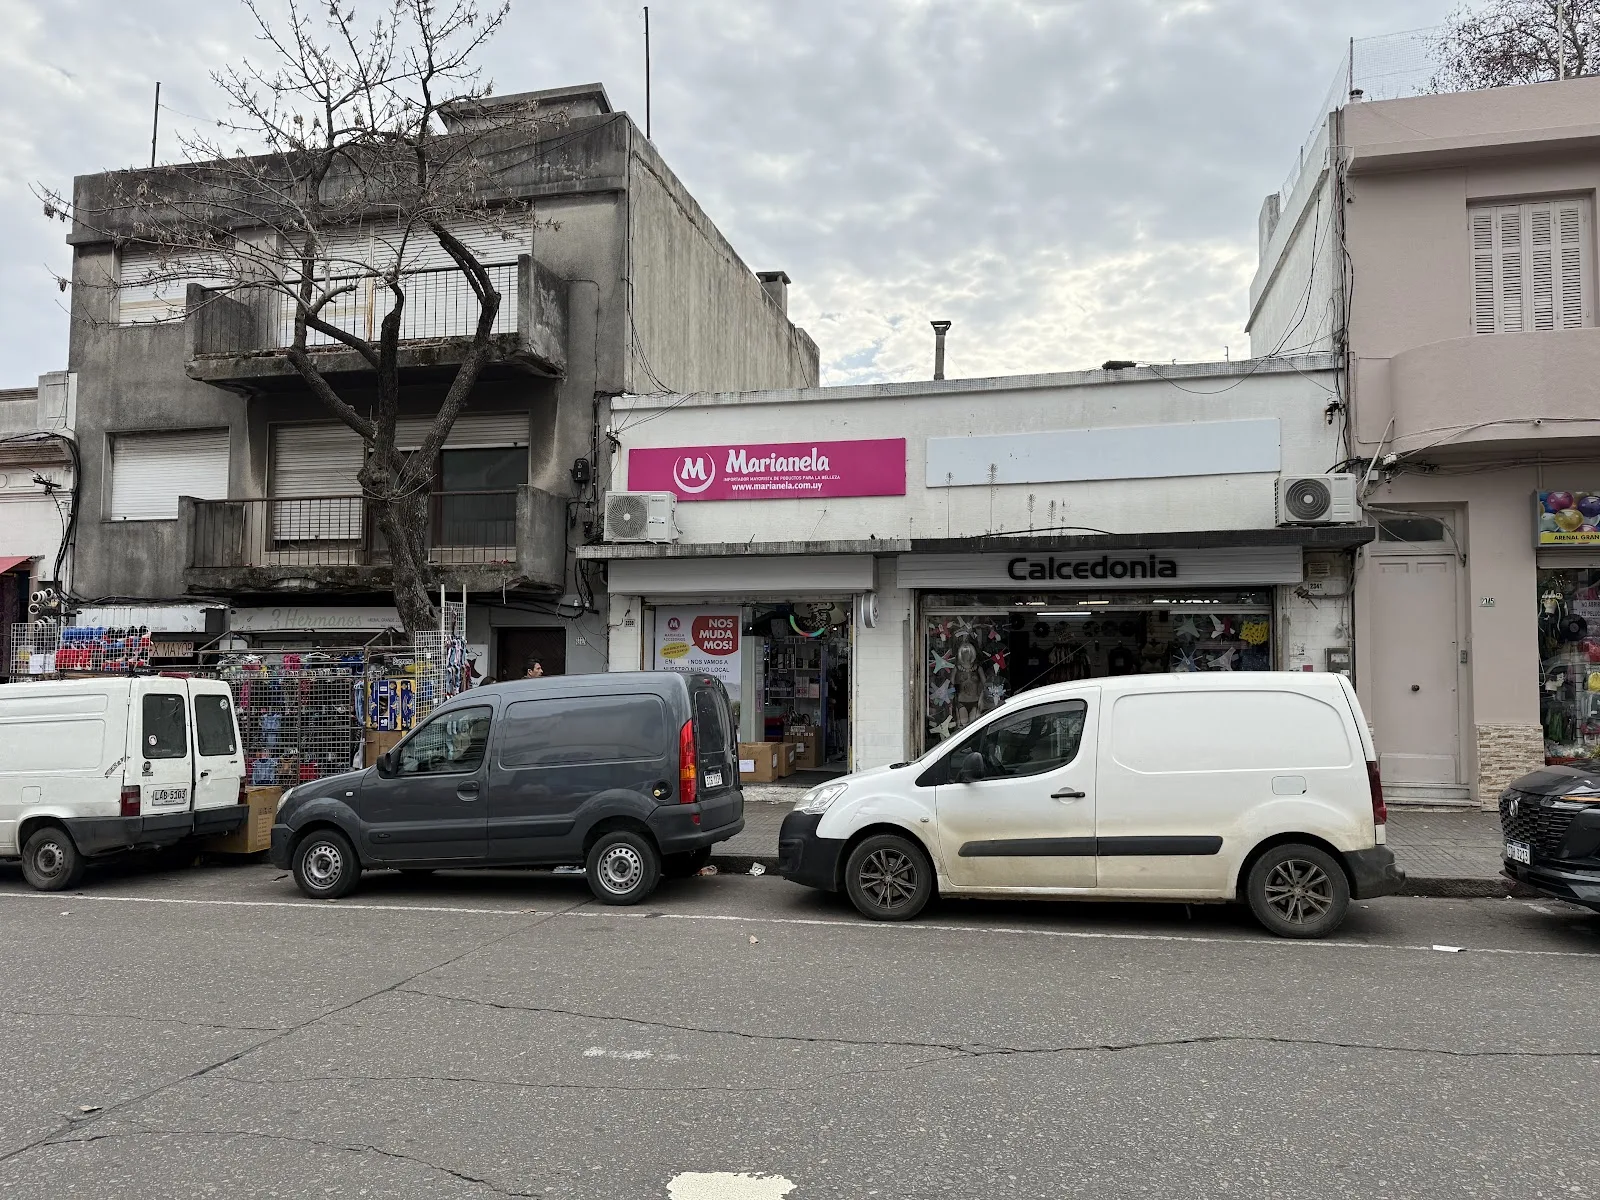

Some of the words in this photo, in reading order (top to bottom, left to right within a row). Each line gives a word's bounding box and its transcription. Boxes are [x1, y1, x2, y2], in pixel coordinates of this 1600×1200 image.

[725, 447, 830, 474] Marianela
[681, 457, 708, 481] M
[731, 480, 823, 491] www.marianela.com.uy
[1007, 554, 1177, 581] Calcedonia
[271, 608, 281, 630] 3
[284, 608, 363, 629] Hermanos
[708, 618, 734, 628] NOS
[699, 630, 734, 639] MUDA
[162, 641, 193, 656] MAYOR
[703, 641, 733, 650] MOS!
